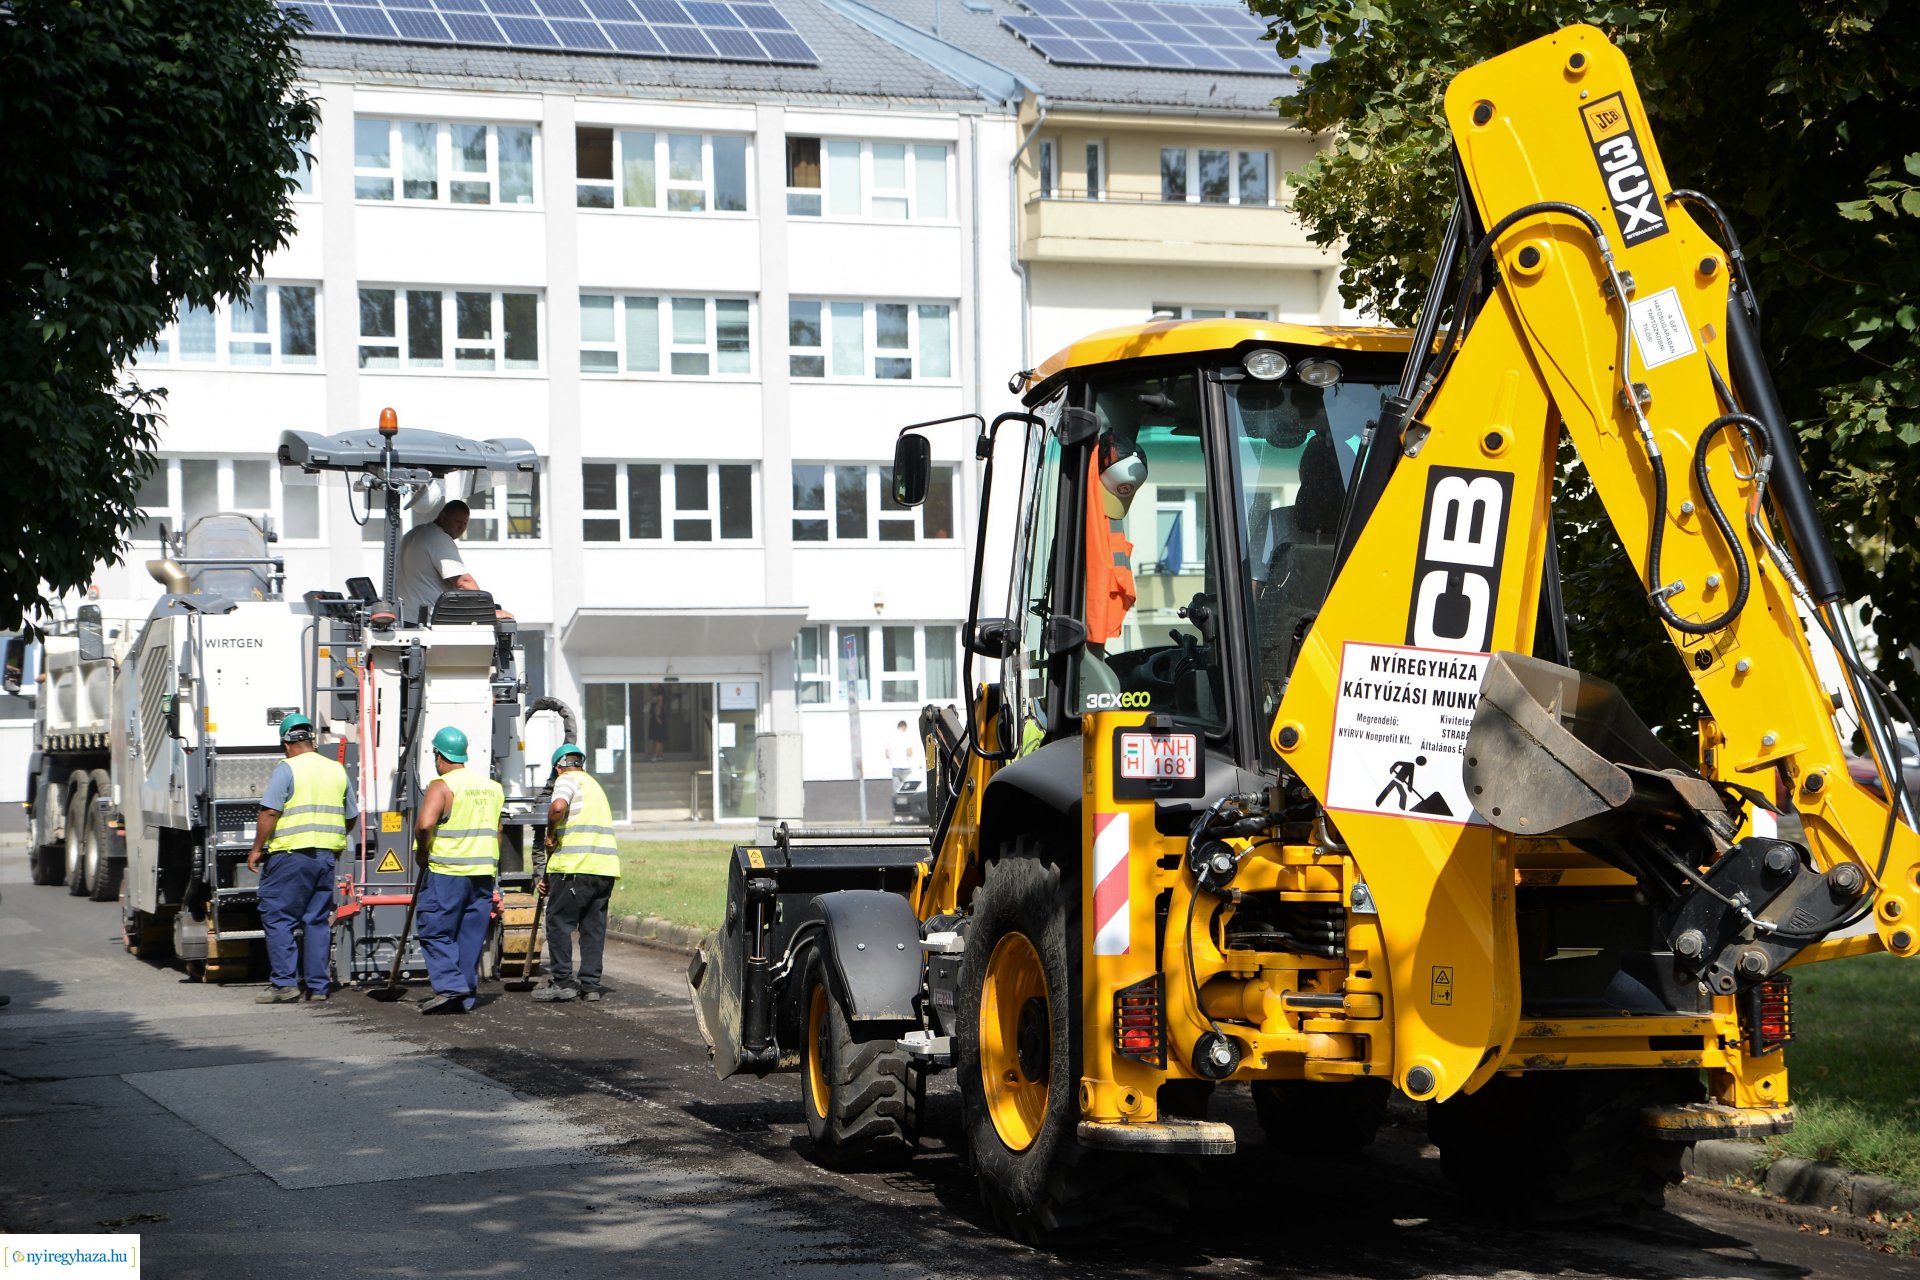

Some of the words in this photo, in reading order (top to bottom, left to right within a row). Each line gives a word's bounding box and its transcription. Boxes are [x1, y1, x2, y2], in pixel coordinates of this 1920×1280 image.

[1595, 110, 1619, 130] JCB
[1599, 135, 1663, 235] 3CX
[1626, 222, 1664, 240] SITEMASTER
[204, 638, 263, 648] WIRTGEN
[1370, 652, 1477, 681] NYÍREGYHÁZA
[1343, 677, 1427, 705] KÁTYÚZÁSI
[1365, 731, 1398, 744] Nonprofit
[1399, 734, 1412, 745] Kft.
[1420, 738, 1456, 754] Általános
[1150, 739, 1189, 756] YNH
[1127, 757, 1139, 770] H
[1154, 757, 1185, 775] 168
